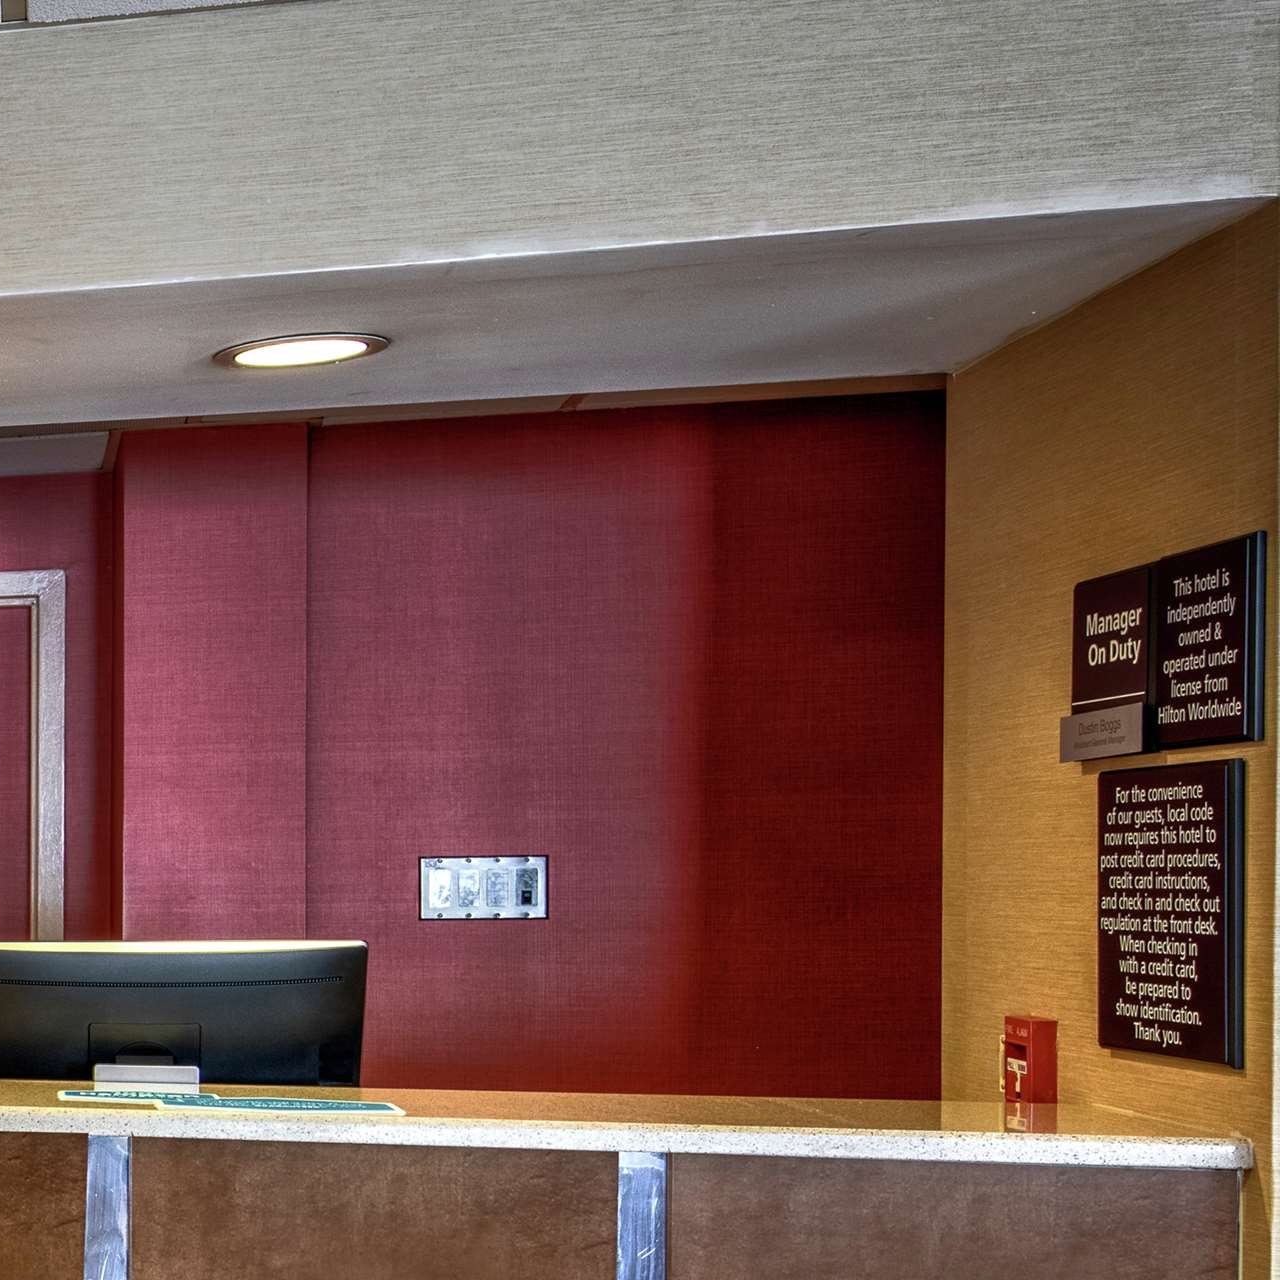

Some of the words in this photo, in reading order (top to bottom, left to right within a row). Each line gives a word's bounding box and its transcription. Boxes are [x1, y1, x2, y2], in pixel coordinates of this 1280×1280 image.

[1173, 578, 1191, 597] This
[1194, 569, 1219, 592] hotel
[1222, 568, 1229, 587] is
[1167, 593, 1236, 624] independently
[1086, 607, 1142, 637] Manager
[1178, 622, 1211, 646] owned
[1214, 622, 1222, 640] &
[1088, 644, 1106, 666] On
[1110, 637, 1141, 664] Duty
[1163, 649, 1205, 678] operated
[1208, 645, 1238, 666] under
[1171, 680, 1201, 698] license
[1205, 674, 1228, 693] from
[1158, 703, 1185, 724] Hilton
[1188, 697, 1242, 720] Worldwide
[1116, 787, 1128, 803] For
[1131, 785, 1146, 802] the
[1148, 782, 1203, 801] convenience
[1107, 807, 1116, 824] of
[1118, 812, 1132, 824] our
[1135, 807, 1164, 828] guests,
[1167, 803, 1188, 822] local
[1191, 802, 1213, 821] code
[1104, 833, 1123, 846] now
[1125, 827, 1158, 849] requires
[1161, 826, 1176, 844] this
[1179, 824, 1203, 844] hotel
[1206, 826, 1216, 843] to
[1101, 853, 1118, 872] post
[1120, 850, 1144, 868] credit
[1146, 849, 1164, 867] card
[1167, 849, 1220, 871] procedures,
[1109, 871, 1133, 888] credit
[1135, 871, 1153, 888] card
[1155, 872, 1210, 892] instructions,
[1101, 892, 1116, 909] and
[1119, 892, 1142, 909] check
[1145, 893, 1152, 910] in
[1155, 893, 1172, 911] and
[1175, 893, 1200, 912] check
[1203, 896, 1220, 912] out
[1101, 913, 1140, 934] regulation
[1143, 916, 1152, 932] at
[1154, 914, 1168, 932] the
[1170, 914, 1192, 934] front
[1194, 916, 1218, 935] desk.
[1120, 934, 1145, 952] When
[1147, 936, 1186, 960] checking
[1189, 939, 1197, 956] in
[1119, 956, 1138, 974] with
[1140, 961, 1146, 974] a
[1148, 958, 1173, 976] credit
[1176, 960, 1198, 981] card,
[1126, 976, 1136, 994] be
[1139, 981, 1178, 1000] prepared
[1181, 984, 1191, 1000] to
[1116, 998, 1138, 1016] show
[1140, 1000, 1202, 1025] identification.
[1133, 1022, 1160, 1042] Thank
[1162, 1030, 1182, 1047] you.
